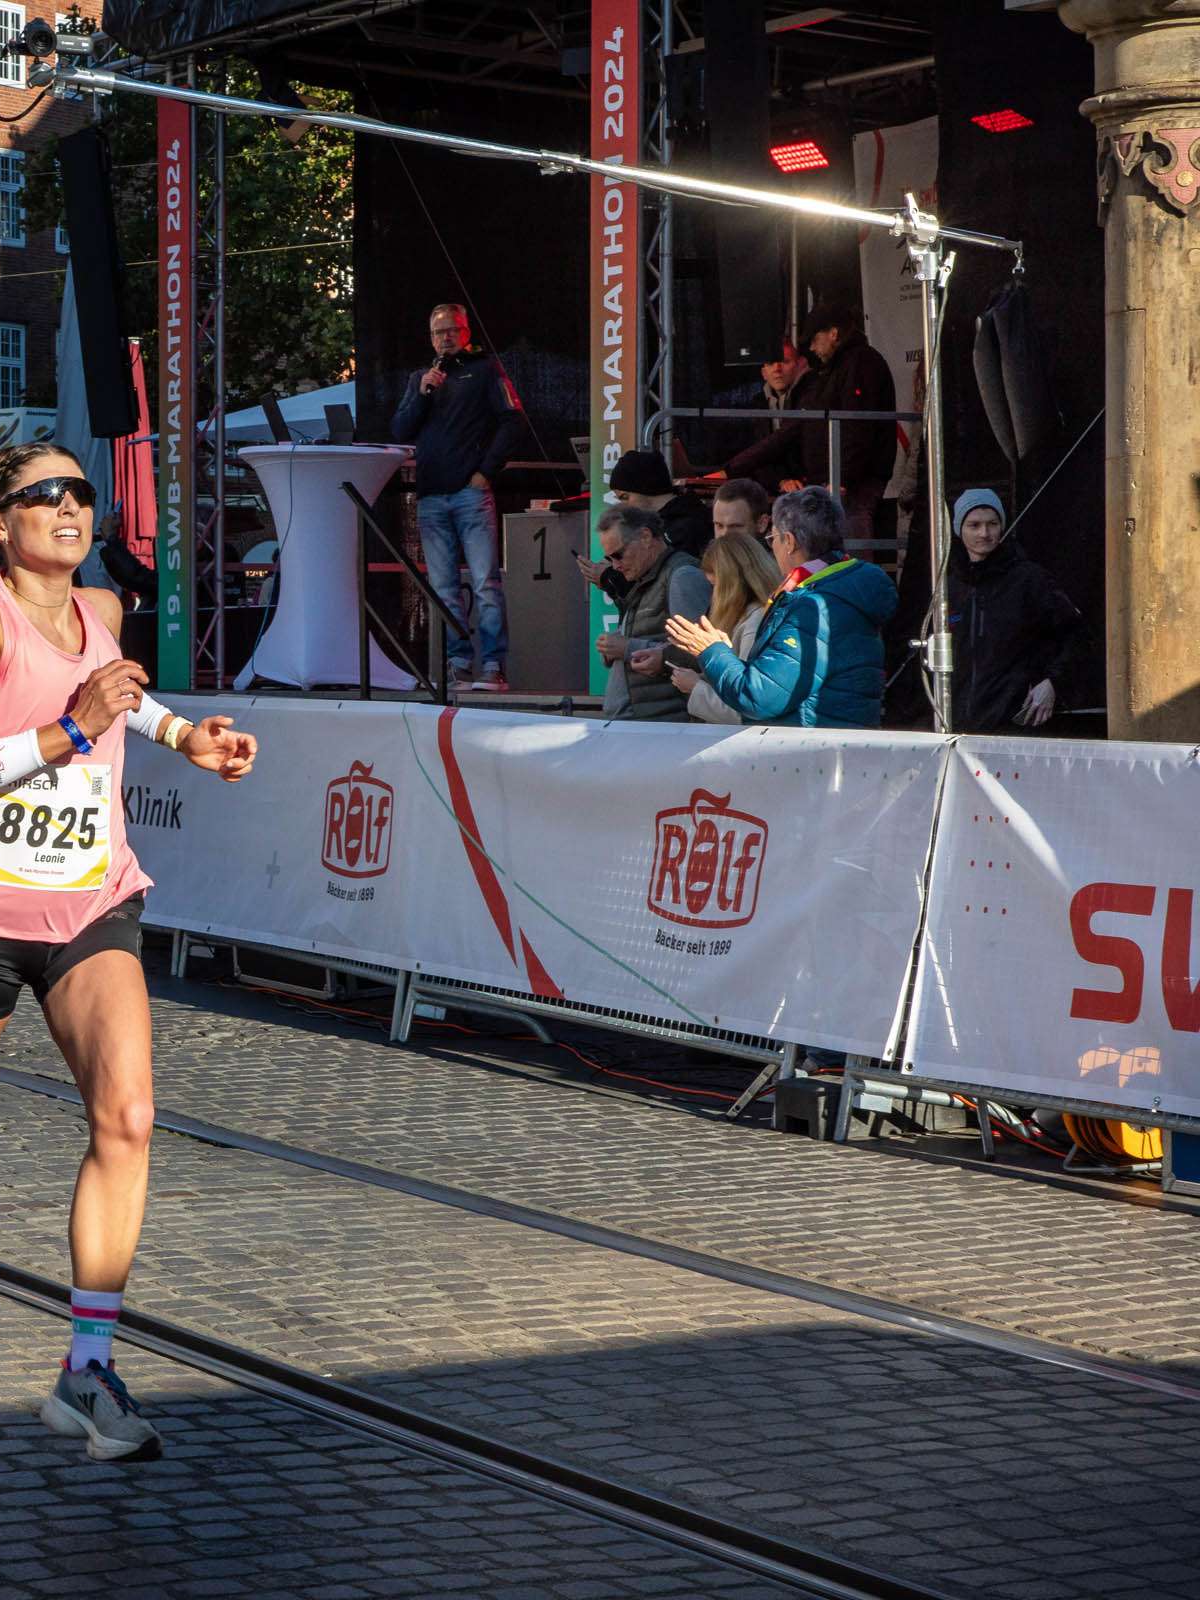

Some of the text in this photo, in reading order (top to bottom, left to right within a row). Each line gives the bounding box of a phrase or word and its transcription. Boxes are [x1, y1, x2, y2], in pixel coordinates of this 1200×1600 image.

[604, 26, 624, 139] 2024
[166, 139, 181, 232] 2024
[167, 244, 181, 571] SWB-MARATHON
[533, 527, 552, 580] 1
[167, 584, 181, 638] 19.
[122, 785, 183, 830] Klinik
[34, 852, 66, 864] Leonie
[327, 881, 347, 900] Bäcker
[357, 887, 375, 902] 1899
[655, 928, 732, 956] Bäcker seit 1899
